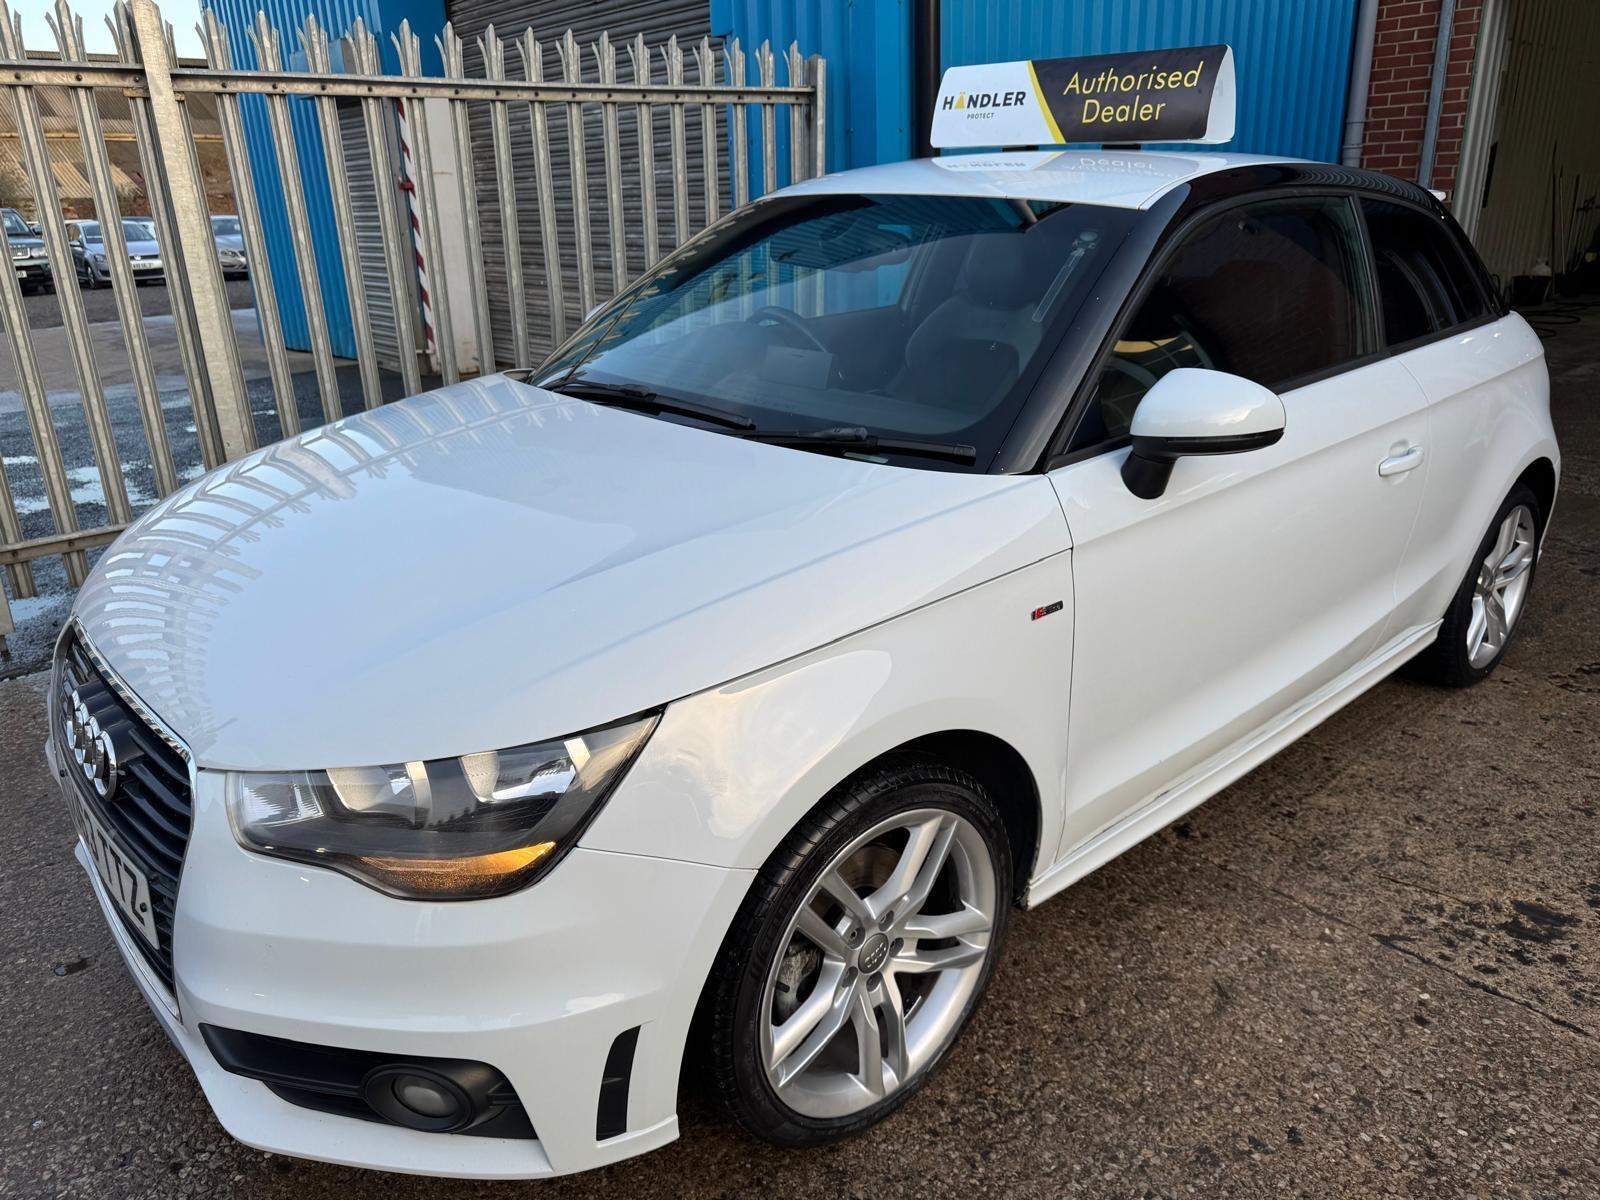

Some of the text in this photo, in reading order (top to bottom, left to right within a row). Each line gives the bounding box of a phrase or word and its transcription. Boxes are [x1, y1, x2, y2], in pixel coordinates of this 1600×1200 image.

[1063, 60, 1204, 95] Authorised
[967, 112, 995, 120] PROTECT
[1082, 94, 1167, 124] Dealer
[96, 828, 145, 927] TTZ
